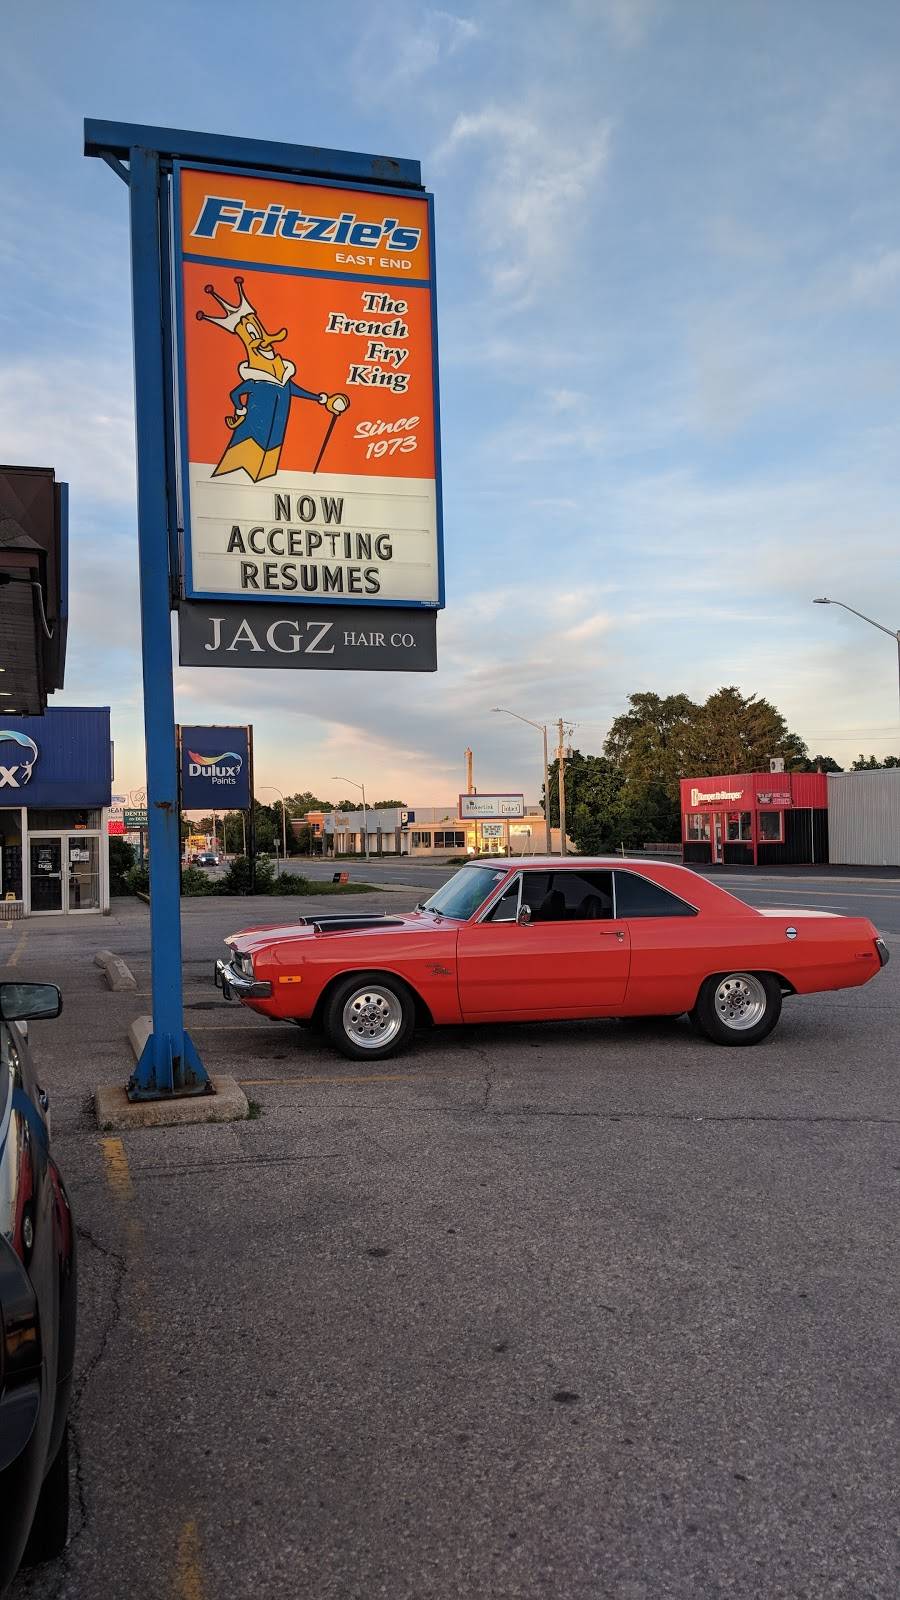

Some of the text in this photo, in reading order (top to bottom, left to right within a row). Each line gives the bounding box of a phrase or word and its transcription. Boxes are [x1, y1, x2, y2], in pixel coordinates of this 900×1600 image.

[191, 195, 421, 252] Fritzie's
[335, 253, 413, 270] EAST END
[363, 292, 408, 314] The
[327, 314, 408, 338] French
[365, 341, 409, 369] Fry
[348, 366, 410, 393] King
[353, 415, 421, 440] Since
[365, 435, 419, 460] 1973
[274, 493, 344, 525] NOW
[226, 525, 394, 561] ACCEPTING
[240, 560, 382, 595] RESUMES
[204, 617, 416, 654] JAGZ HAIR CO.
[189, 762, 236, 777] Dulux
[211, 776, 236, 785] Paints
